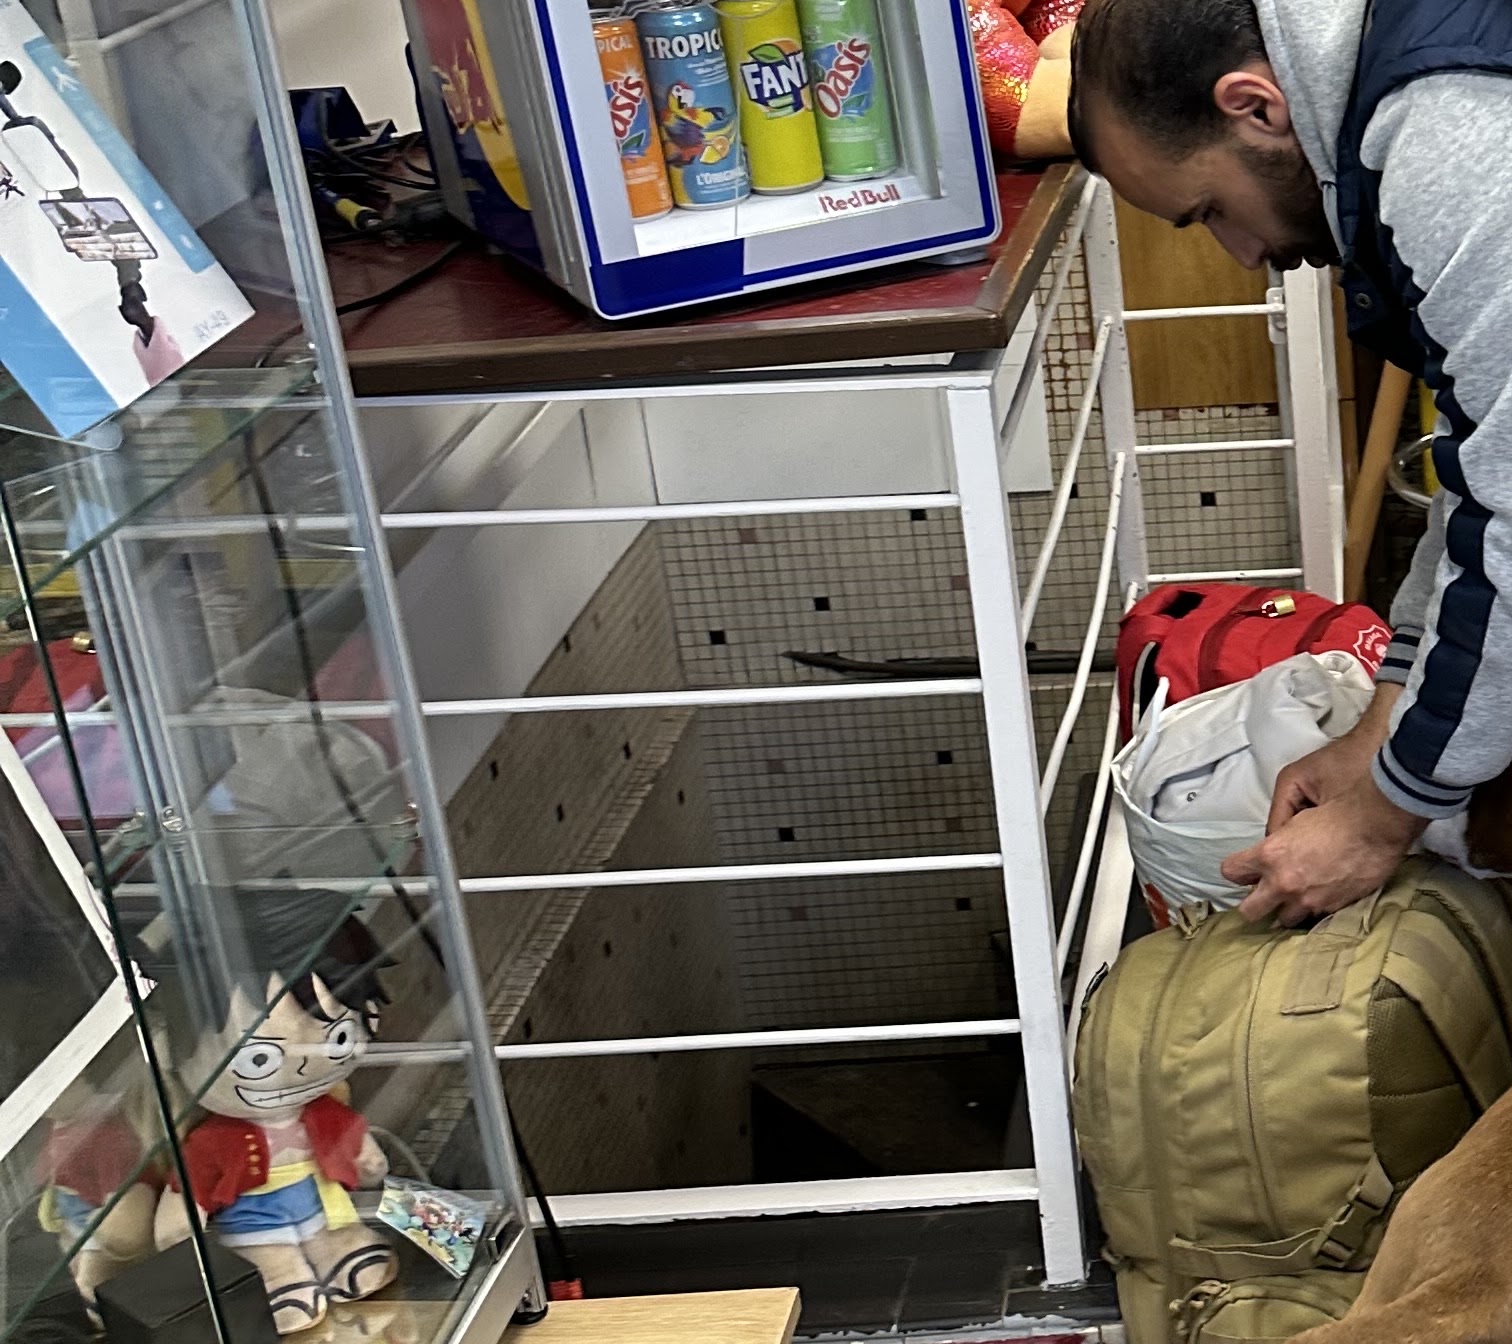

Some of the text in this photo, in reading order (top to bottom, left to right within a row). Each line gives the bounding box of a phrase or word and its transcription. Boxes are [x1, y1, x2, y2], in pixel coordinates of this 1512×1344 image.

[597, 36, 634, 54] PICAL
[743, 51, 809, 100] FANT
[815, 37, 871, 119] Oasis
[610, 76, 645, 139] asis
